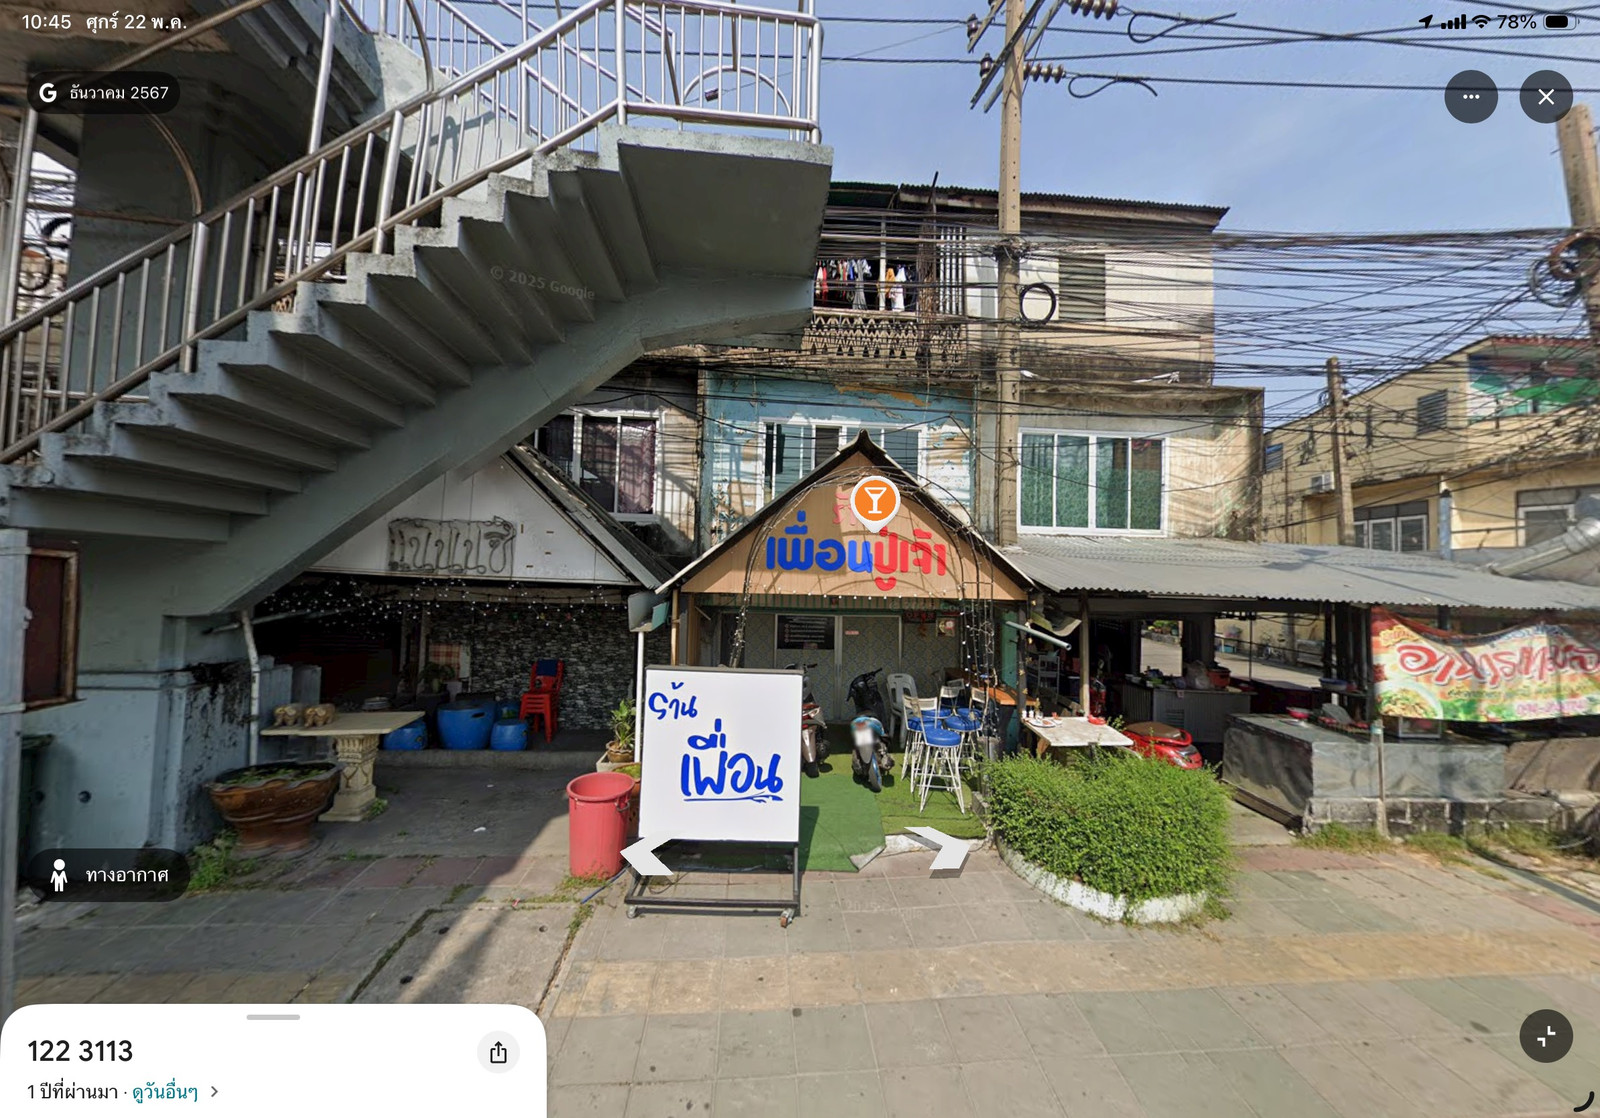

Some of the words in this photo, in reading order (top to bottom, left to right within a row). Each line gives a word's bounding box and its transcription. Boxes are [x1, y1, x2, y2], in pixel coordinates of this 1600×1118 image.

[648, 681, 698, 720] ร้าน
[681, 718, 784, 797] เพื่อน
